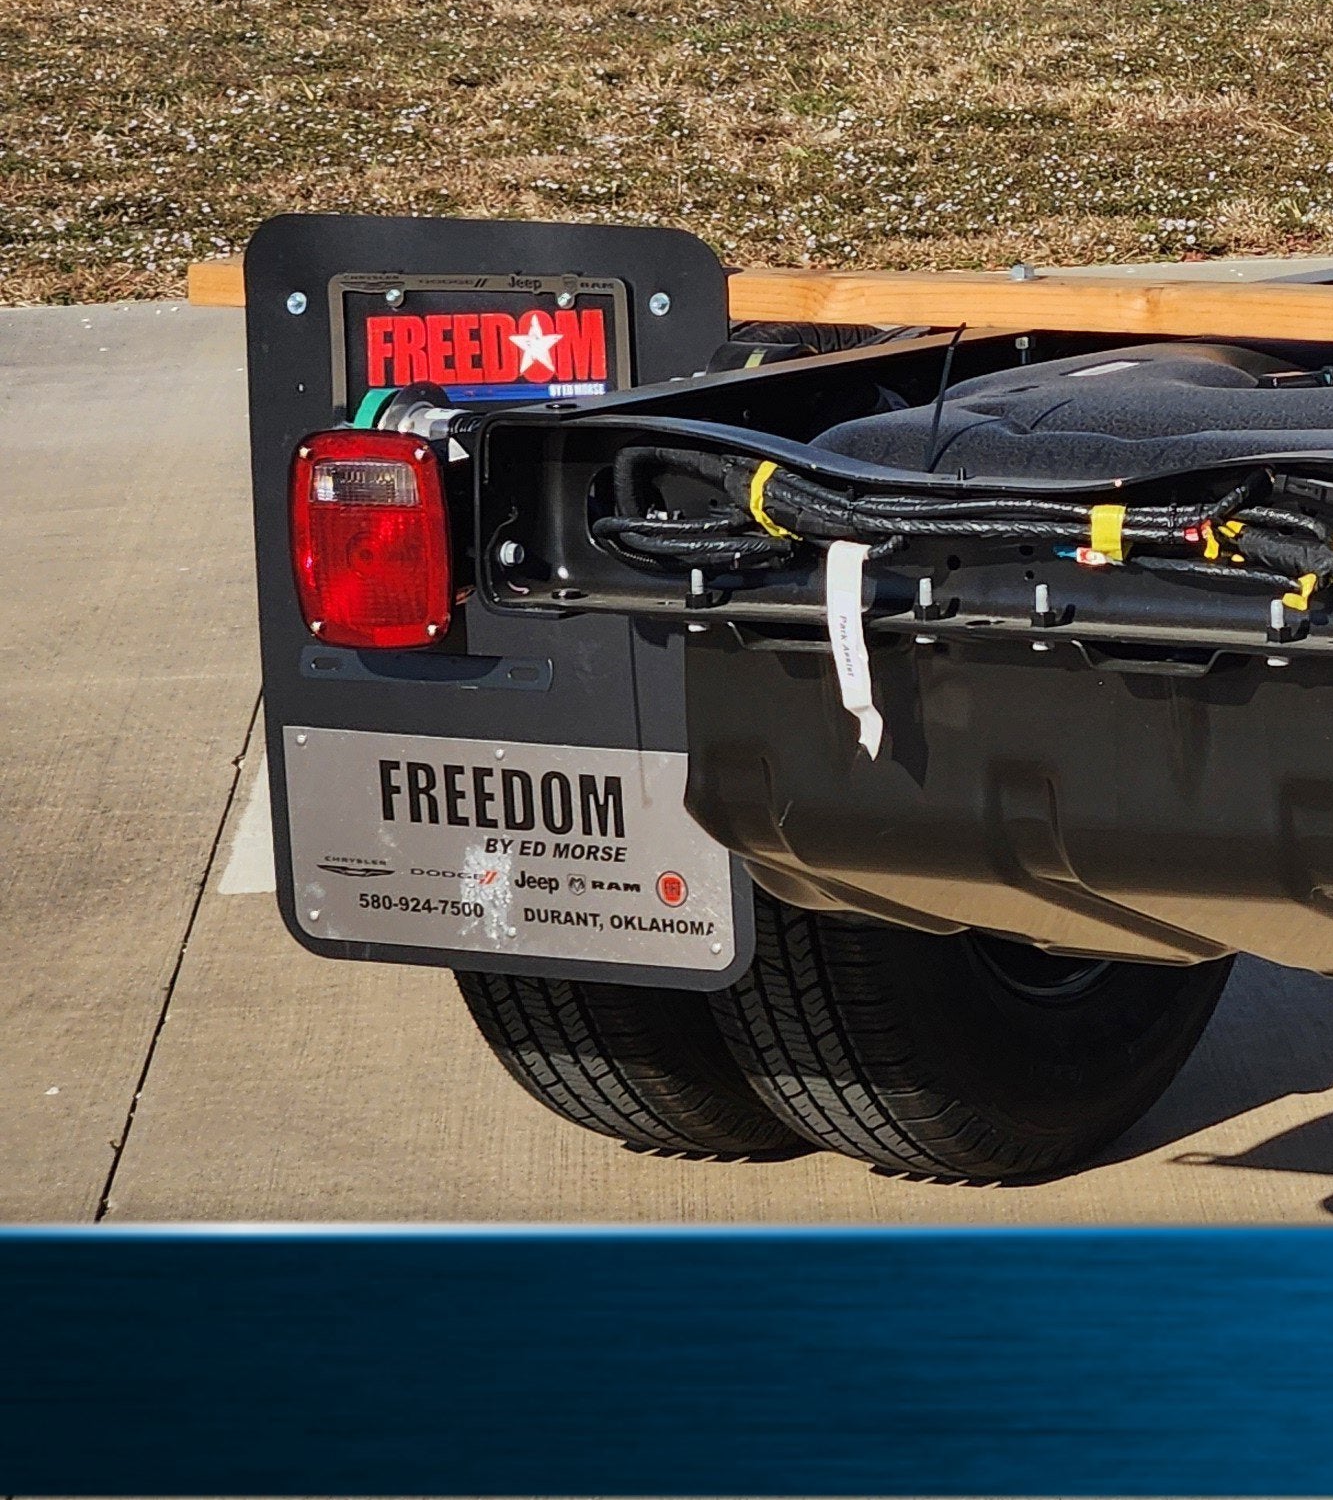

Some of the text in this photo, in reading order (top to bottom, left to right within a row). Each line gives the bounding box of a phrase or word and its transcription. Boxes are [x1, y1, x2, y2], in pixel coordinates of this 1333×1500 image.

[507, 276, 542, 291] Jeep
[366, 309, 606, 387] FREEDOM
[378, 759, 625, 839] FREEDOM
[484, 837, 628, 863] BY ED MORSE
[514, 870, 560, 894] Jeep
[591, 879, 641, 893] RAM
[358, 893, 715, 936] 580-924-7500 DURANT, OKLAHOMA
